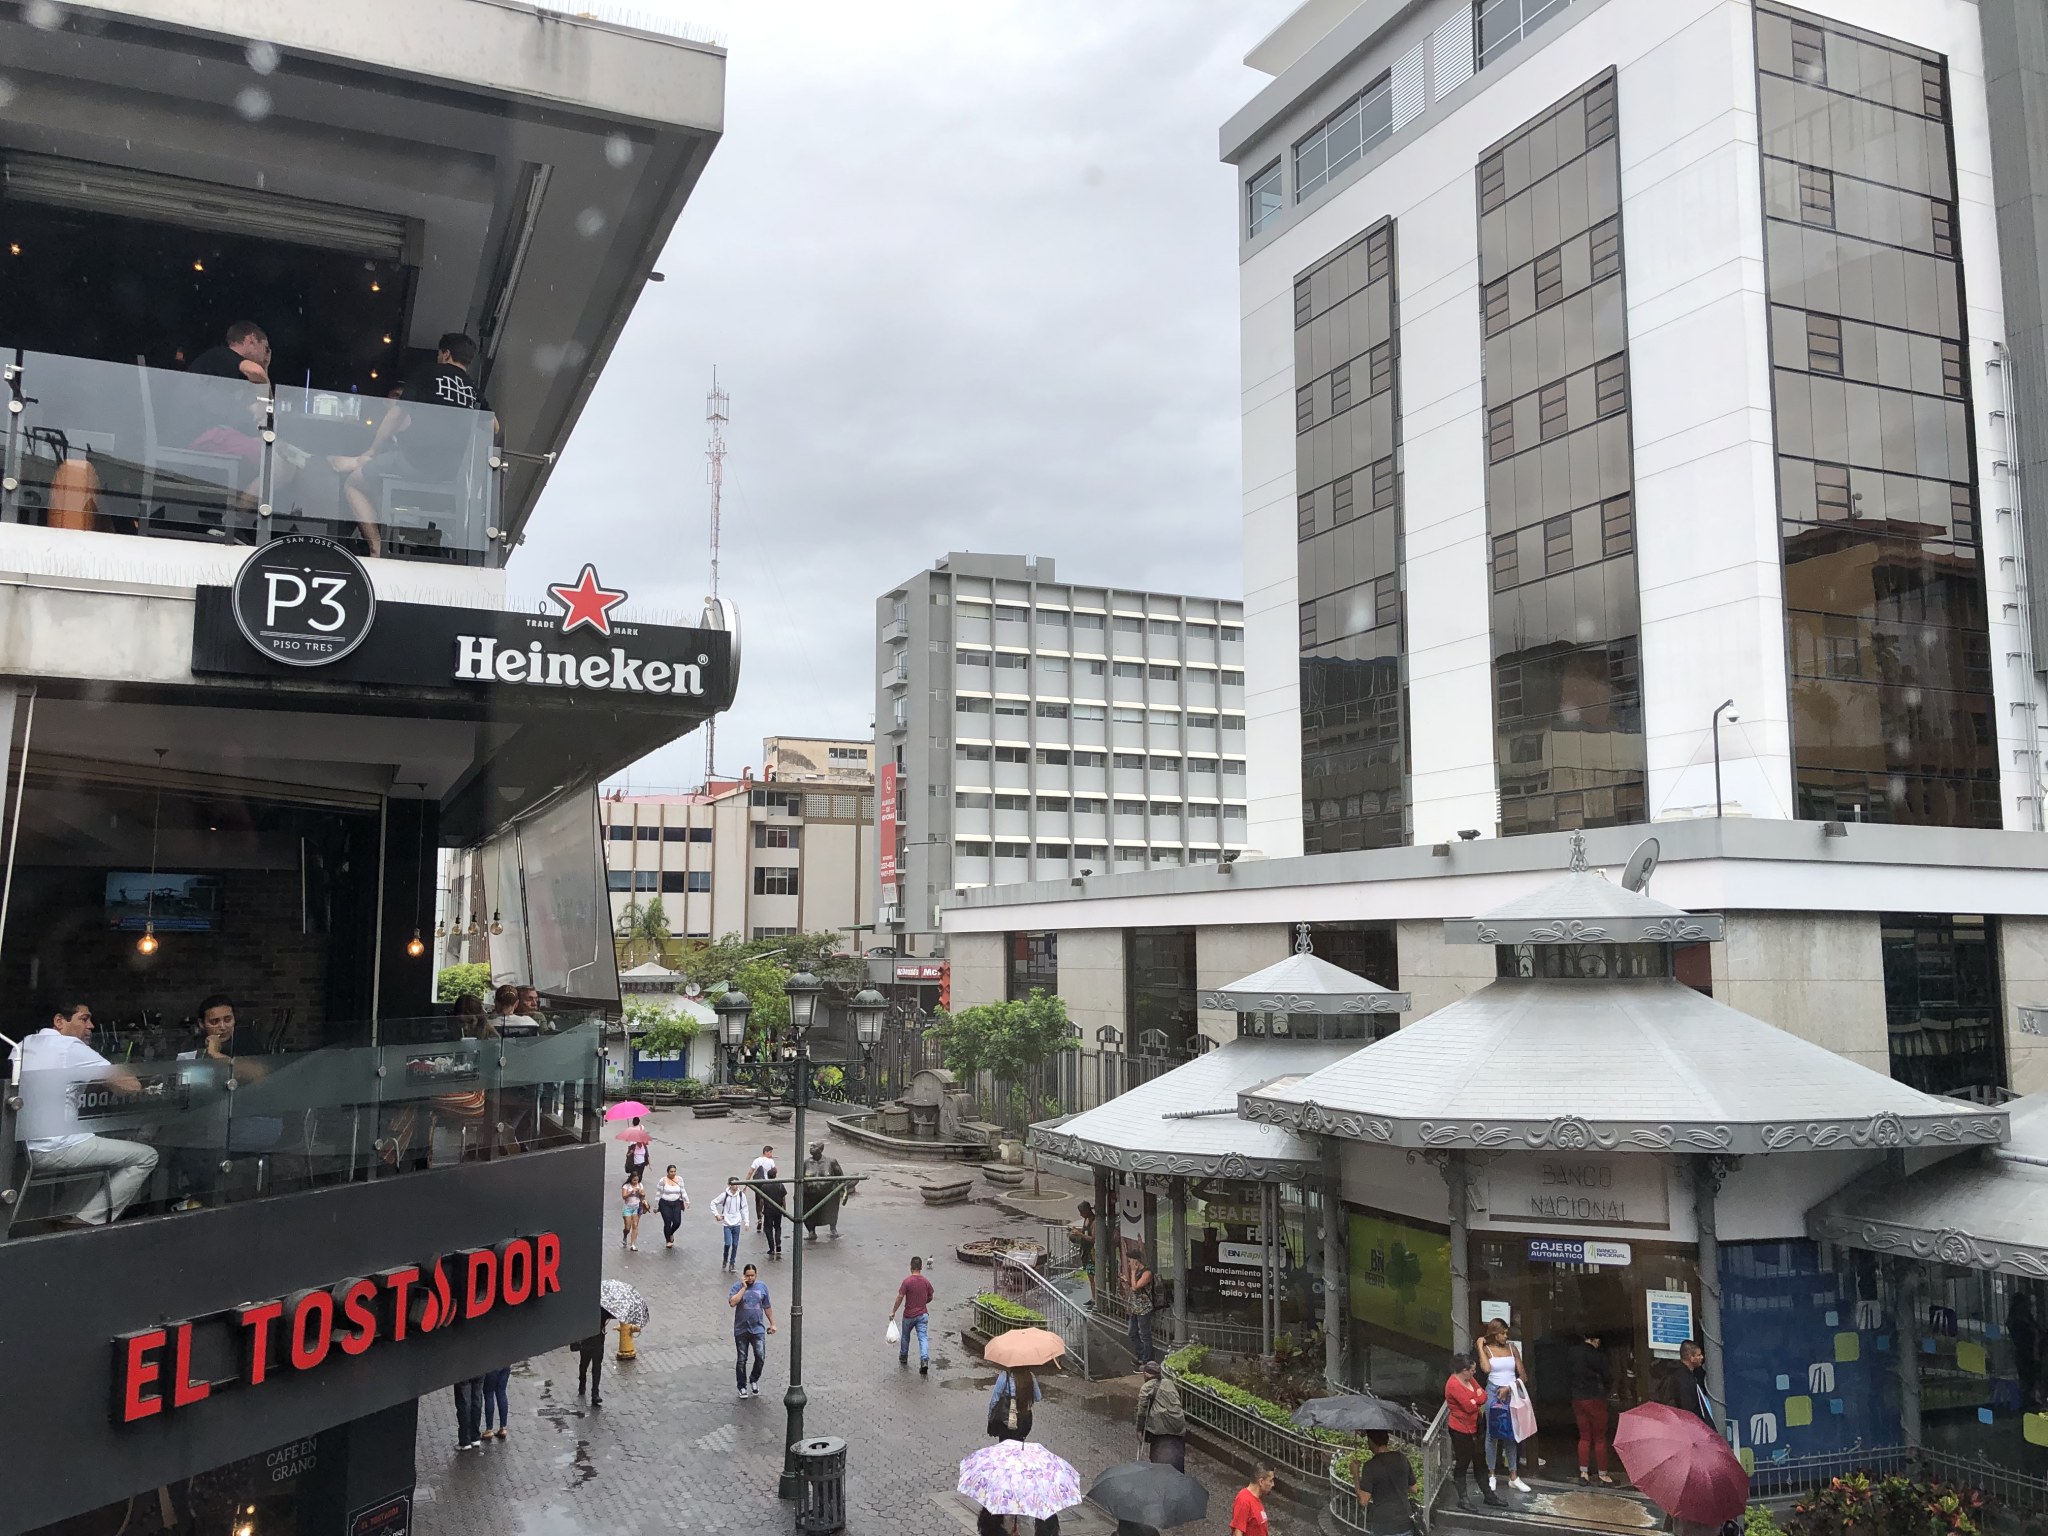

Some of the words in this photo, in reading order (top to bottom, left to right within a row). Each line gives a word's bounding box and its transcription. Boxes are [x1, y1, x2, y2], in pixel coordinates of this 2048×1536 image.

[264, 572, 347, 632] P3
[526, 619, 555, 629] TRADE
[613, 626, 639, 636] MARK
[273, 639, 300, 650] PISO
[304, 642, 333, 652] TRES
[1542, 1164, 1612, 1188] BANCO
[1208, 1205, 1238, 1221] SEA
[1531, 1195, 1632, 1222] NACIONAL
[1530, 1241, 1582, 1253] CAJERO
[1204, 1265, 1261, 1278] Financiamiento
[1219, 1278, 1238, 1288] para
[1247, 1281, 1261, 1289] que
[1250, 1290, 1262, 1299] sin
[124, 1323, 211, 1423] EL
[301, 1437, 317, 1456] EN
[272, 1455, 317, 1482] GRANO
